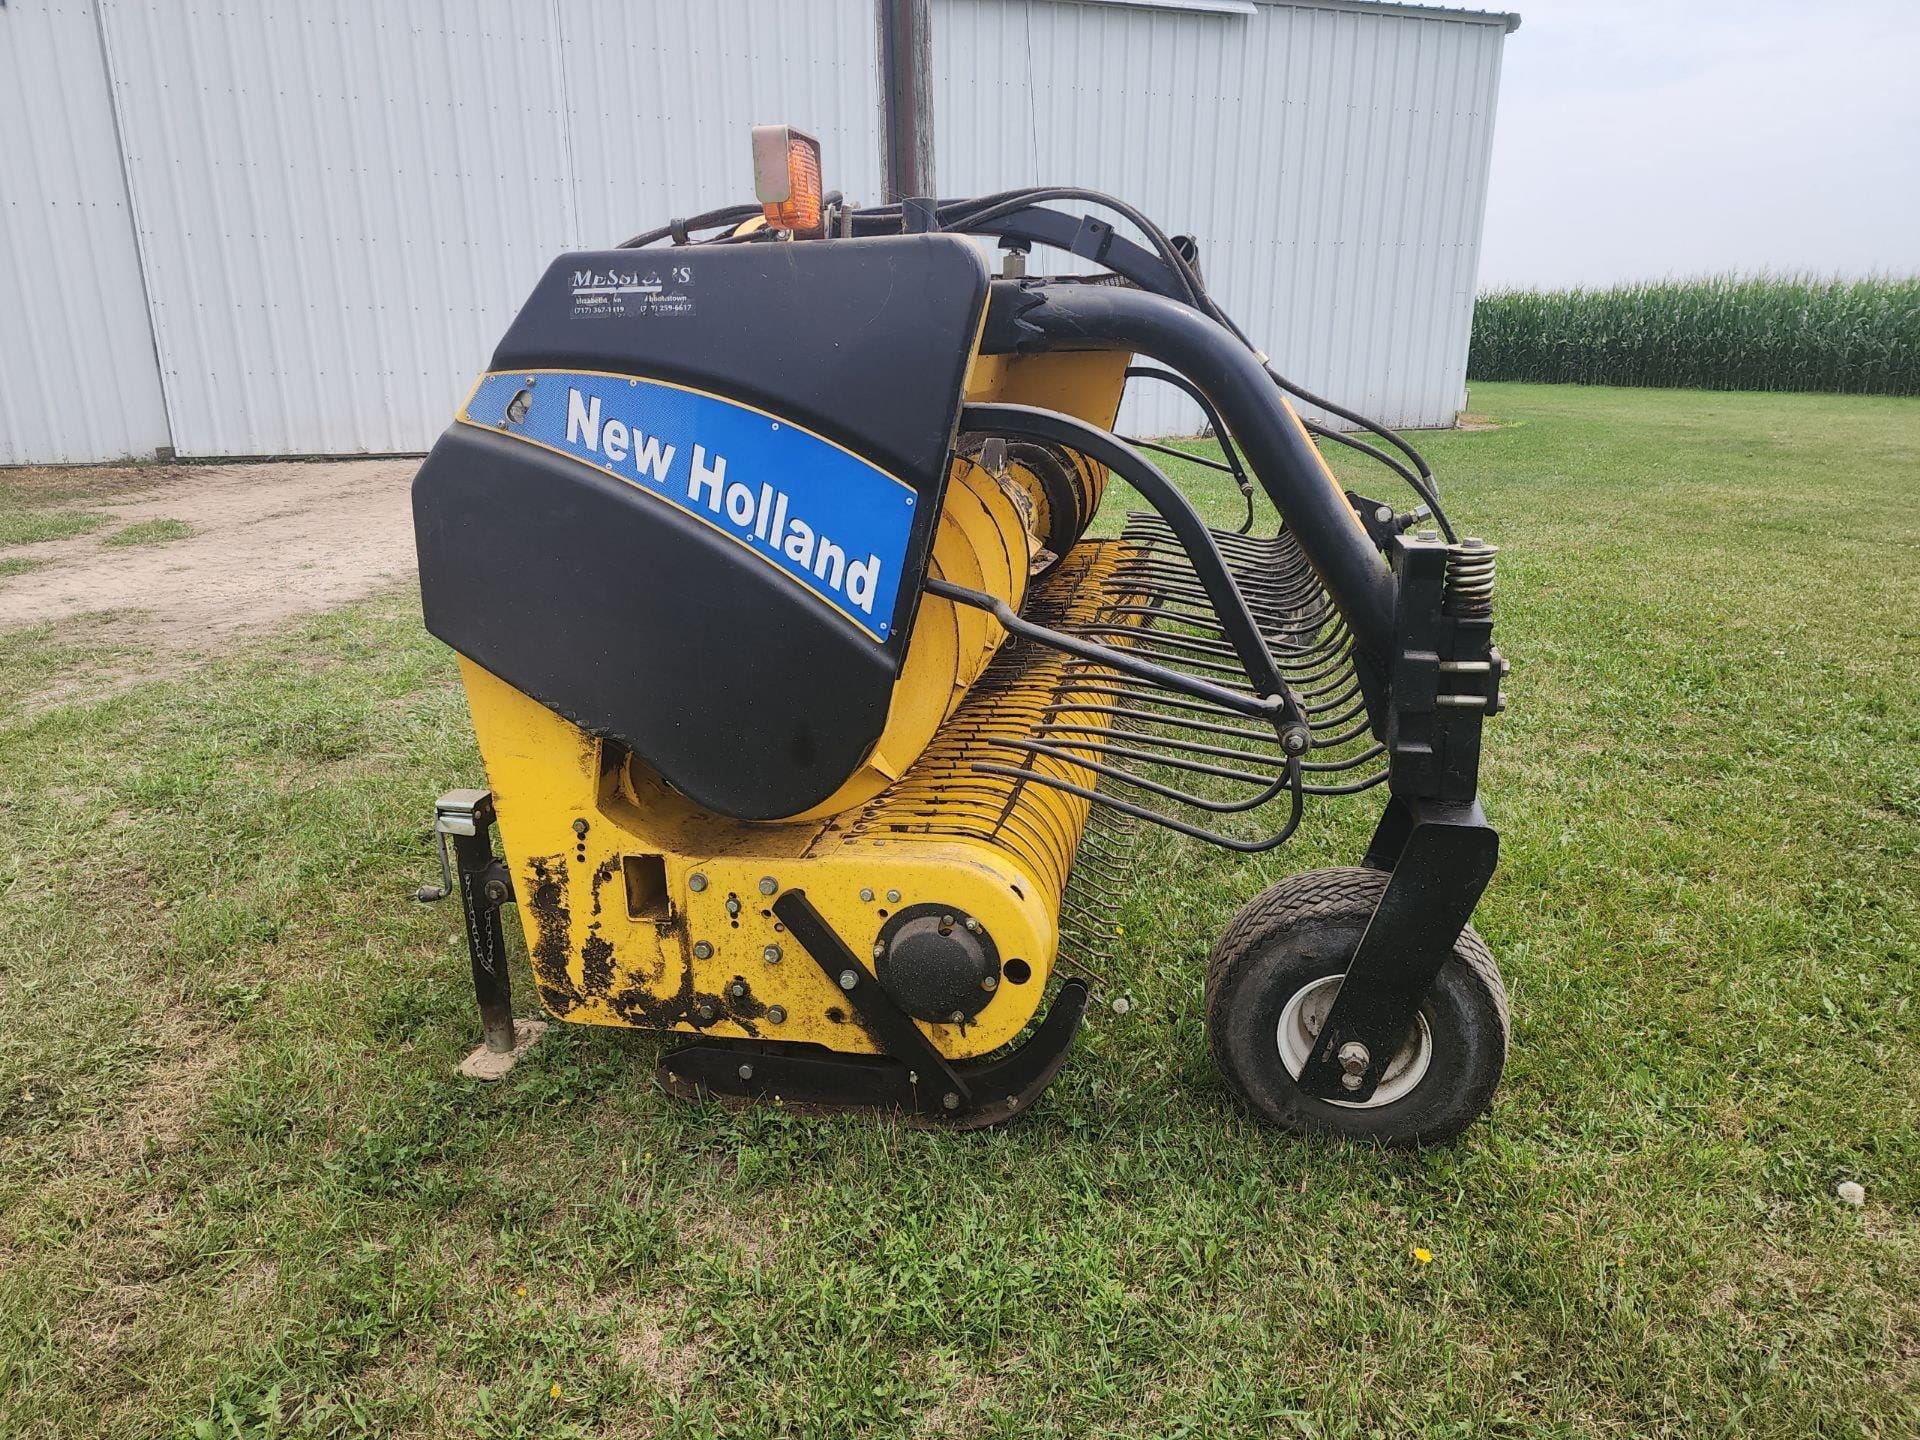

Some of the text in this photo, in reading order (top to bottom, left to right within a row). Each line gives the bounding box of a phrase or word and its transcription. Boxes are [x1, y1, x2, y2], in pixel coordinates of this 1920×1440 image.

[640, 305, 658, 313] (77)
[566, 386, 882, 616] New Holland
